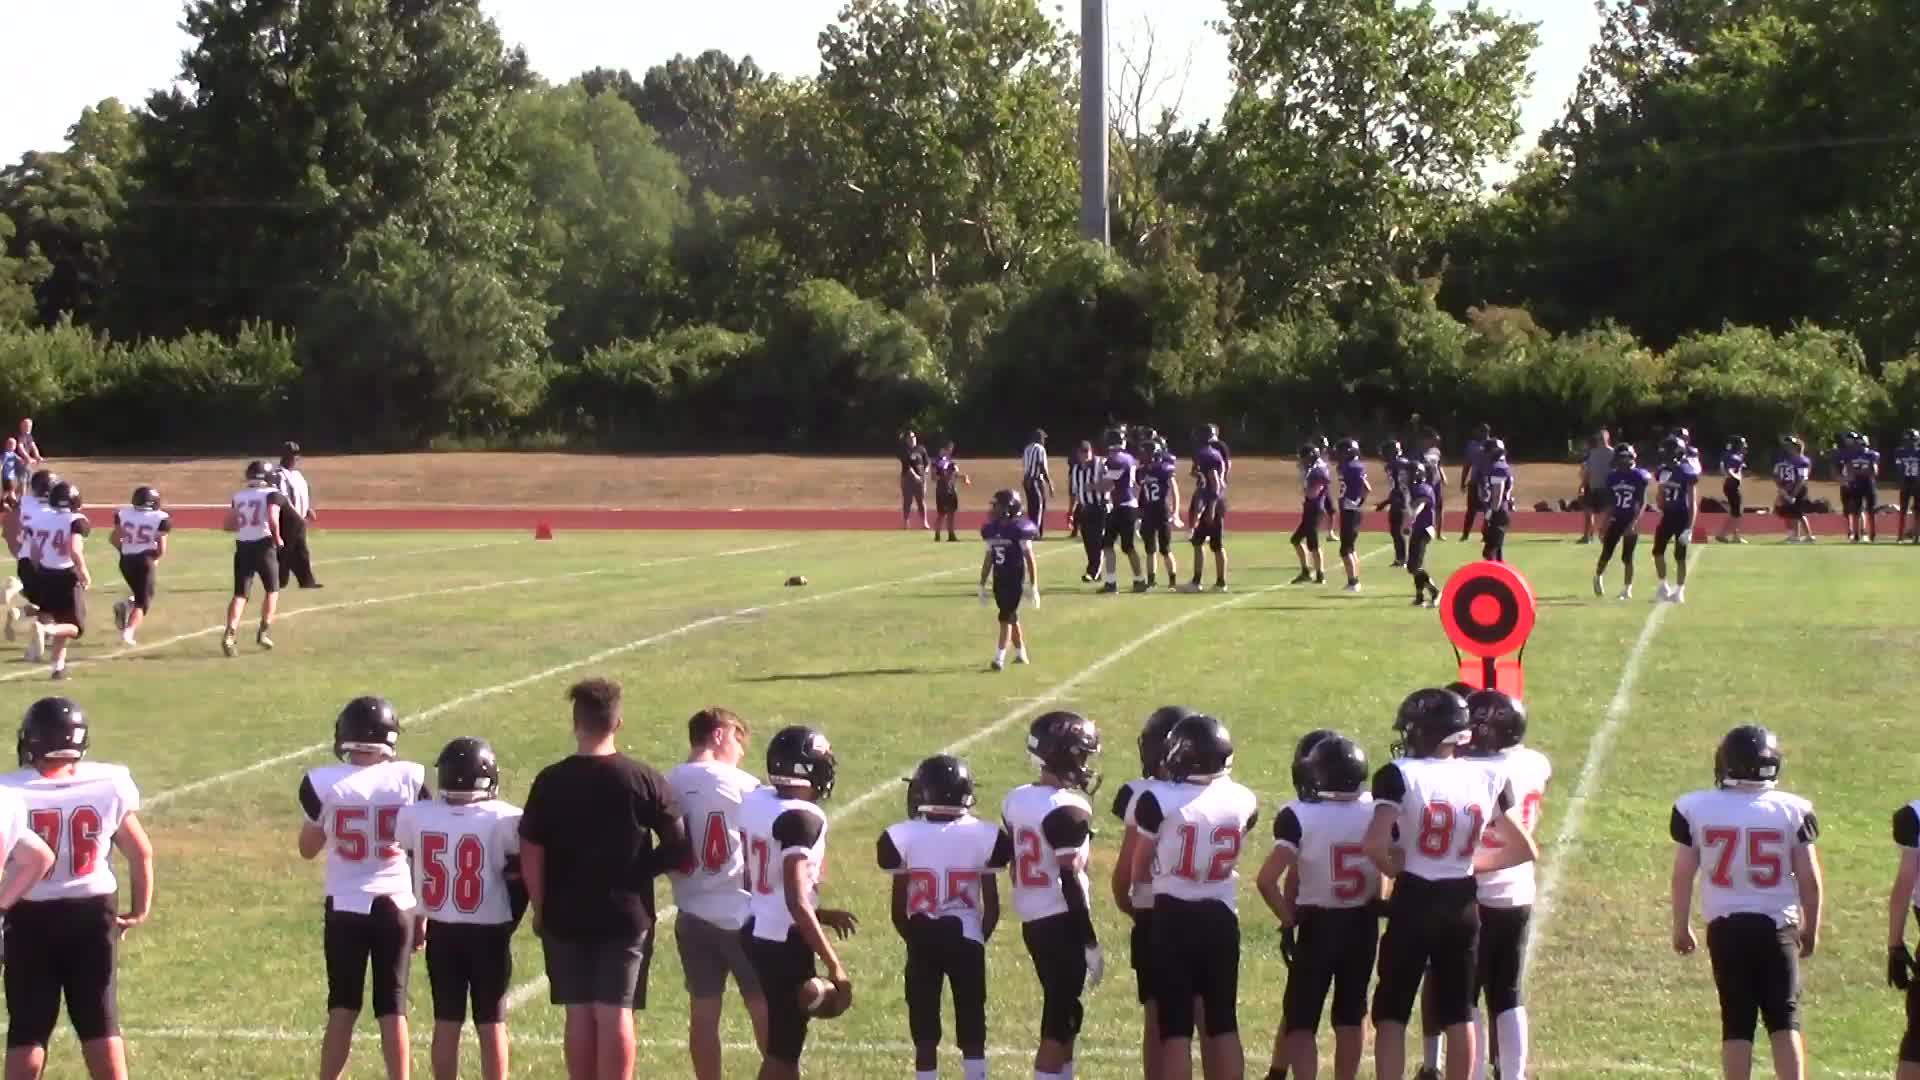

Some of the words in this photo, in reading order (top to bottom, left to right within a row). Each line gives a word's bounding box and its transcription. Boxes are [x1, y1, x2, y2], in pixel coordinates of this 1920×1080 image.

[1616, 490, 1633, 509] 12
[994, 546, 1006, 565] 5
[30, 805, 102, 880] 76
[1017, 828, 1051, 888] 2
[1171, 822, 1242, 883] 12
[1418, 800, 1483, 858] 81
[1702, 826, 1784, 889] 75
[421, 831, 484, 913] 58
[1330, 843, 1368, 898] 5
